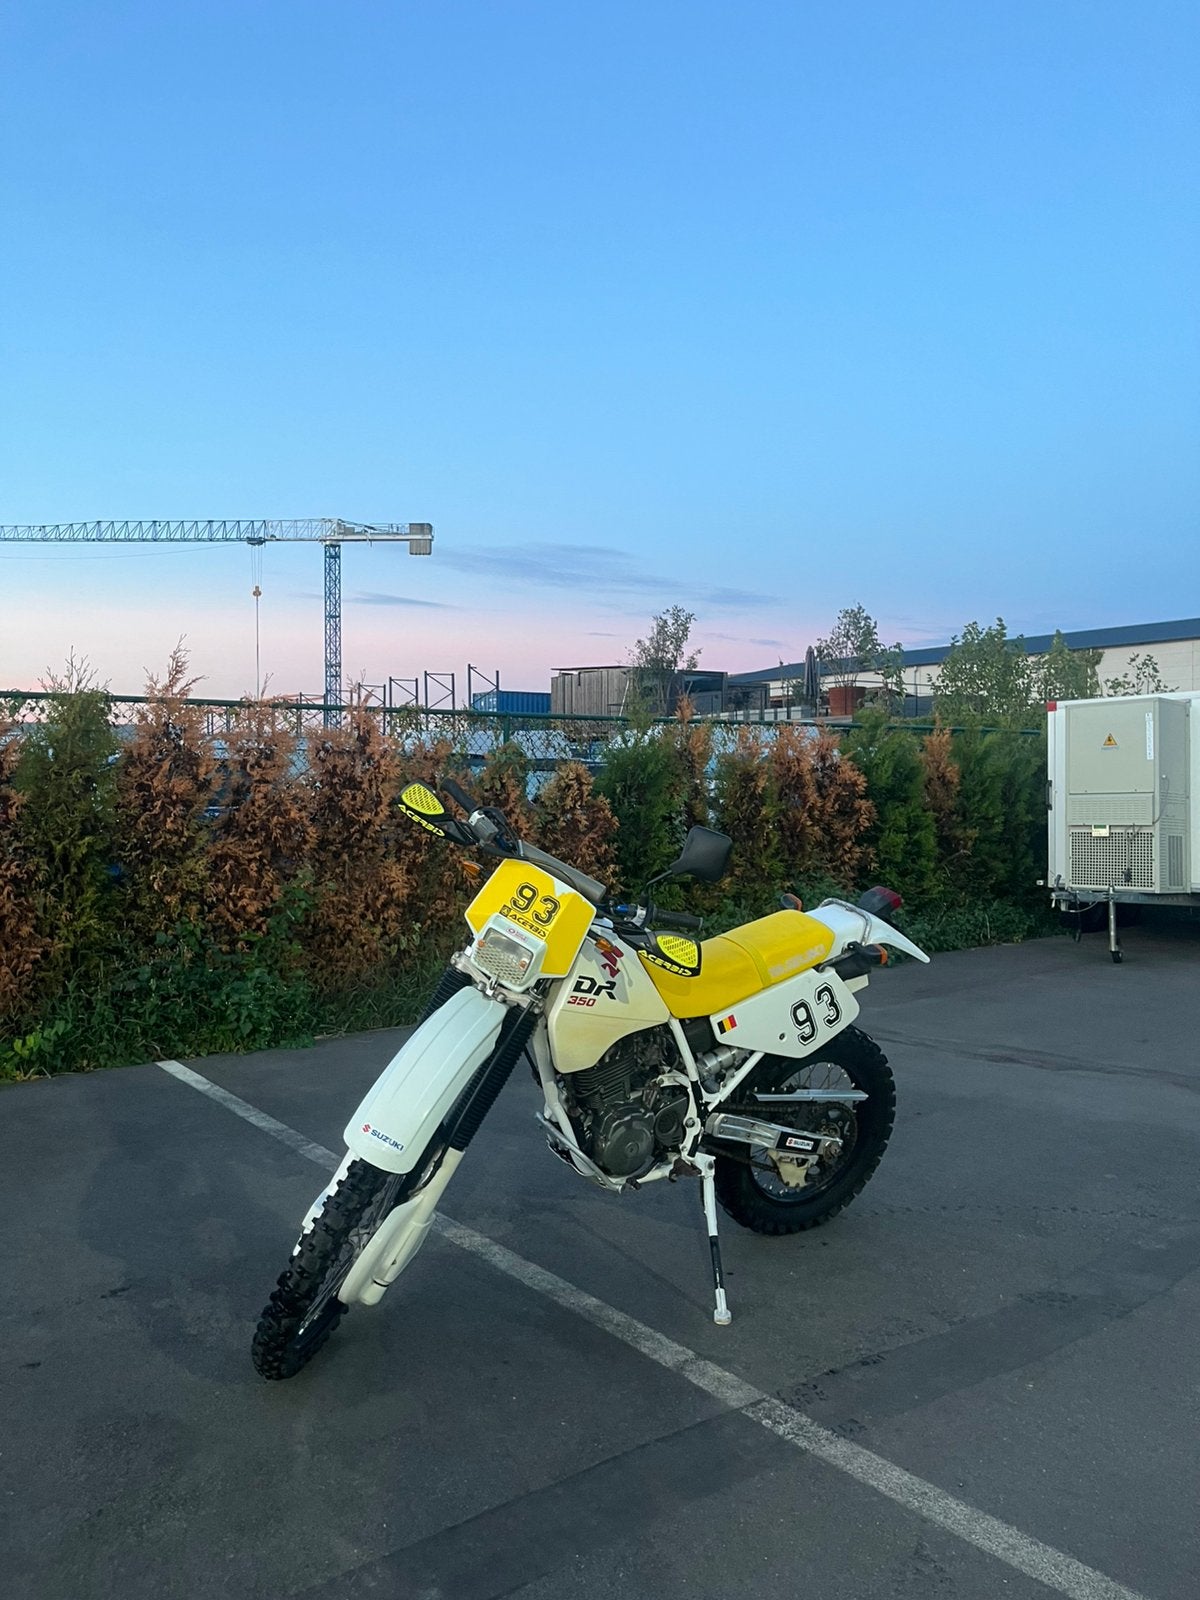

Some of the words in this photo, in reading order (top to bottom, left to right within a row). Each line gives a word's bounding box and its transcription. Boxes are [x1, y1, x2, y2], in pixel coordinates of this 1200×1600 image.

[510, 882, 561, 926] 93
[637, 949, 693, 976] ACERBIS
[572, 975, 617, 1000] DR
[567, 995, 597, 1007] 350
[790, 982, 842, 1046] 93
[371, 1129, 404, 1151] SUZUKI
